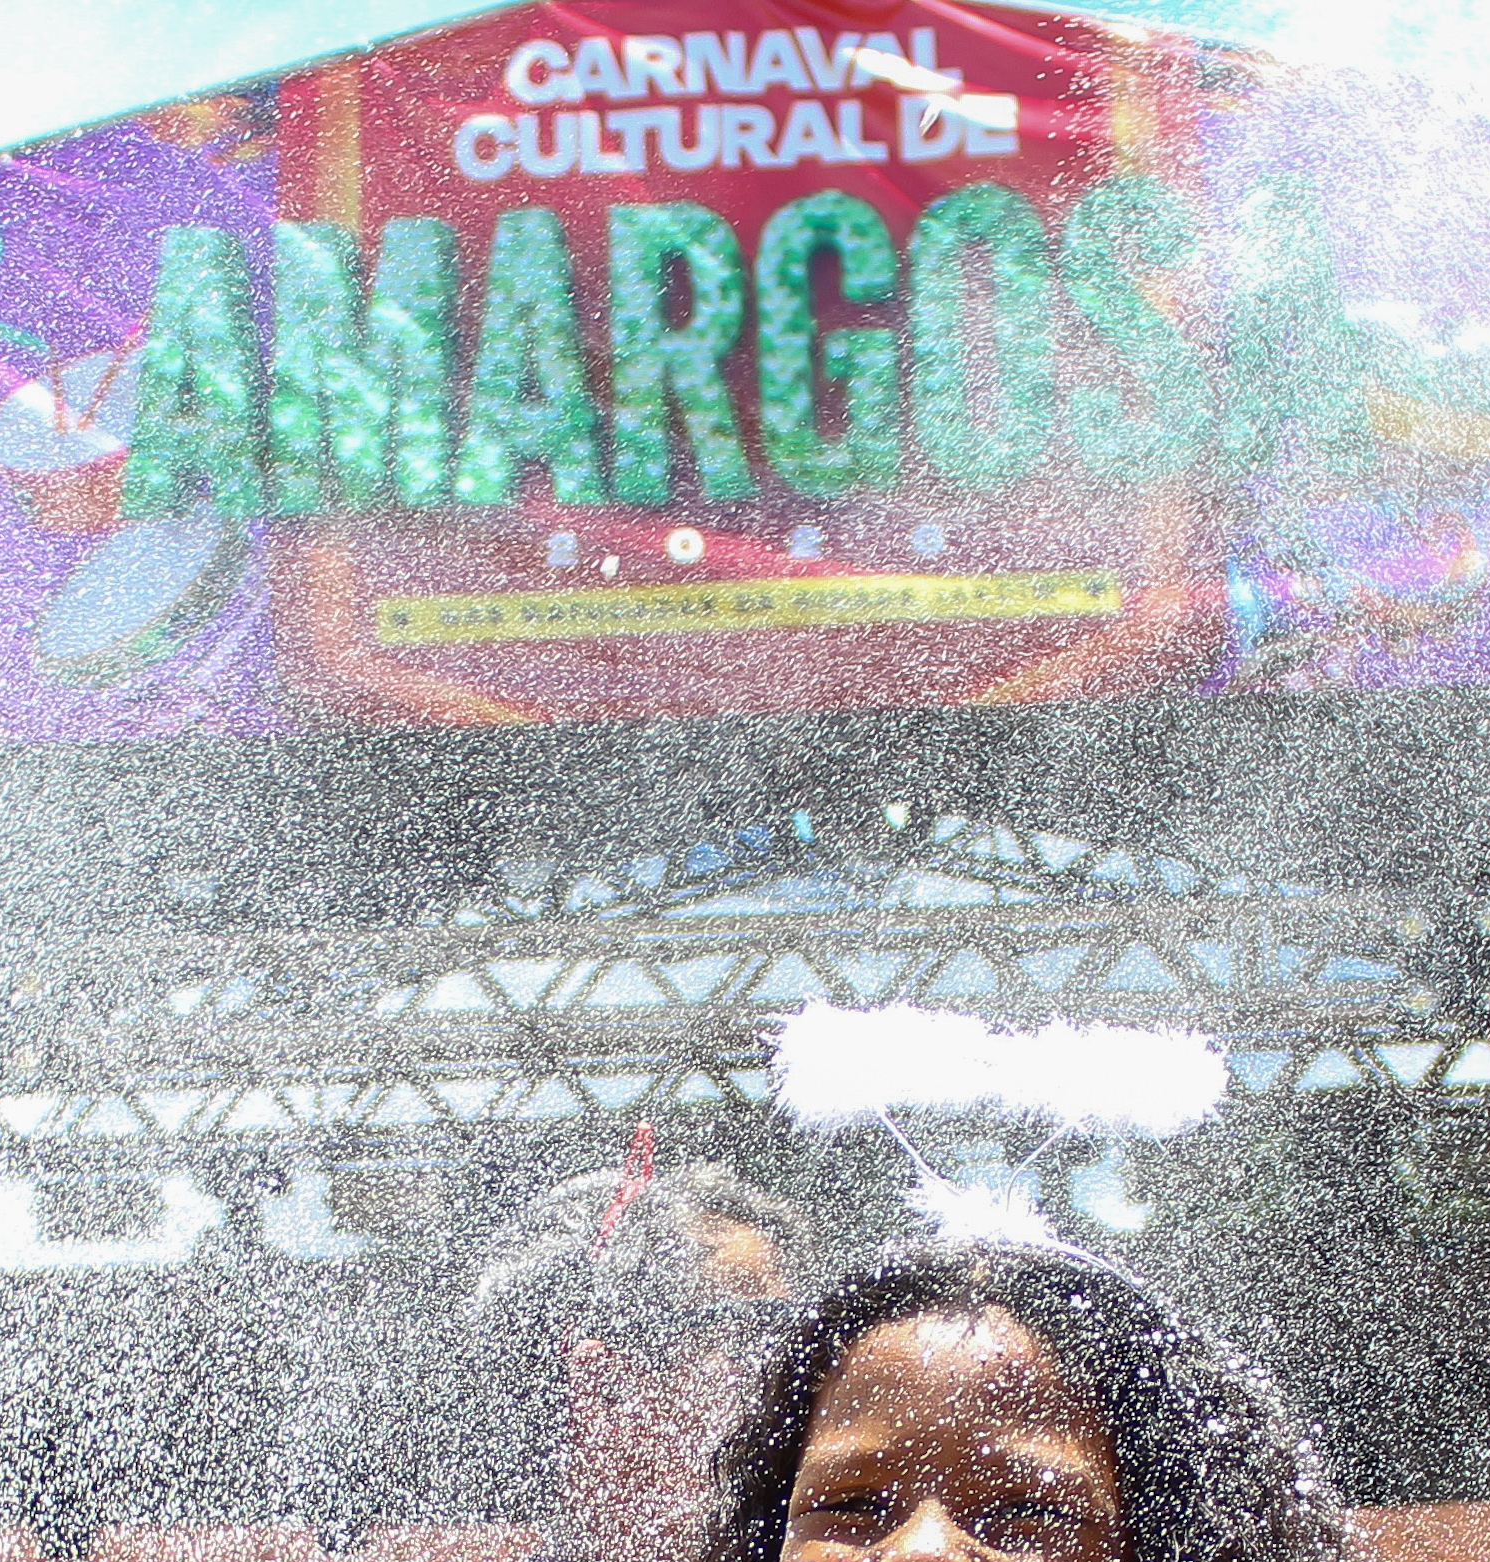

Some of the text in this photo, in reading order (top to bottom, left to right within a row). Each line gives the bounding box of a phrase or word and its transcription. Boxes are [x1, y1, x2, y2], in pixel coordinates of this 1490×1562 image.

[506, 26, 965, 104] CARNAVAL
[452, 93, 1021, 182] CULTURAL DE
[118, 173, 1373, 521] AMARGOSA
